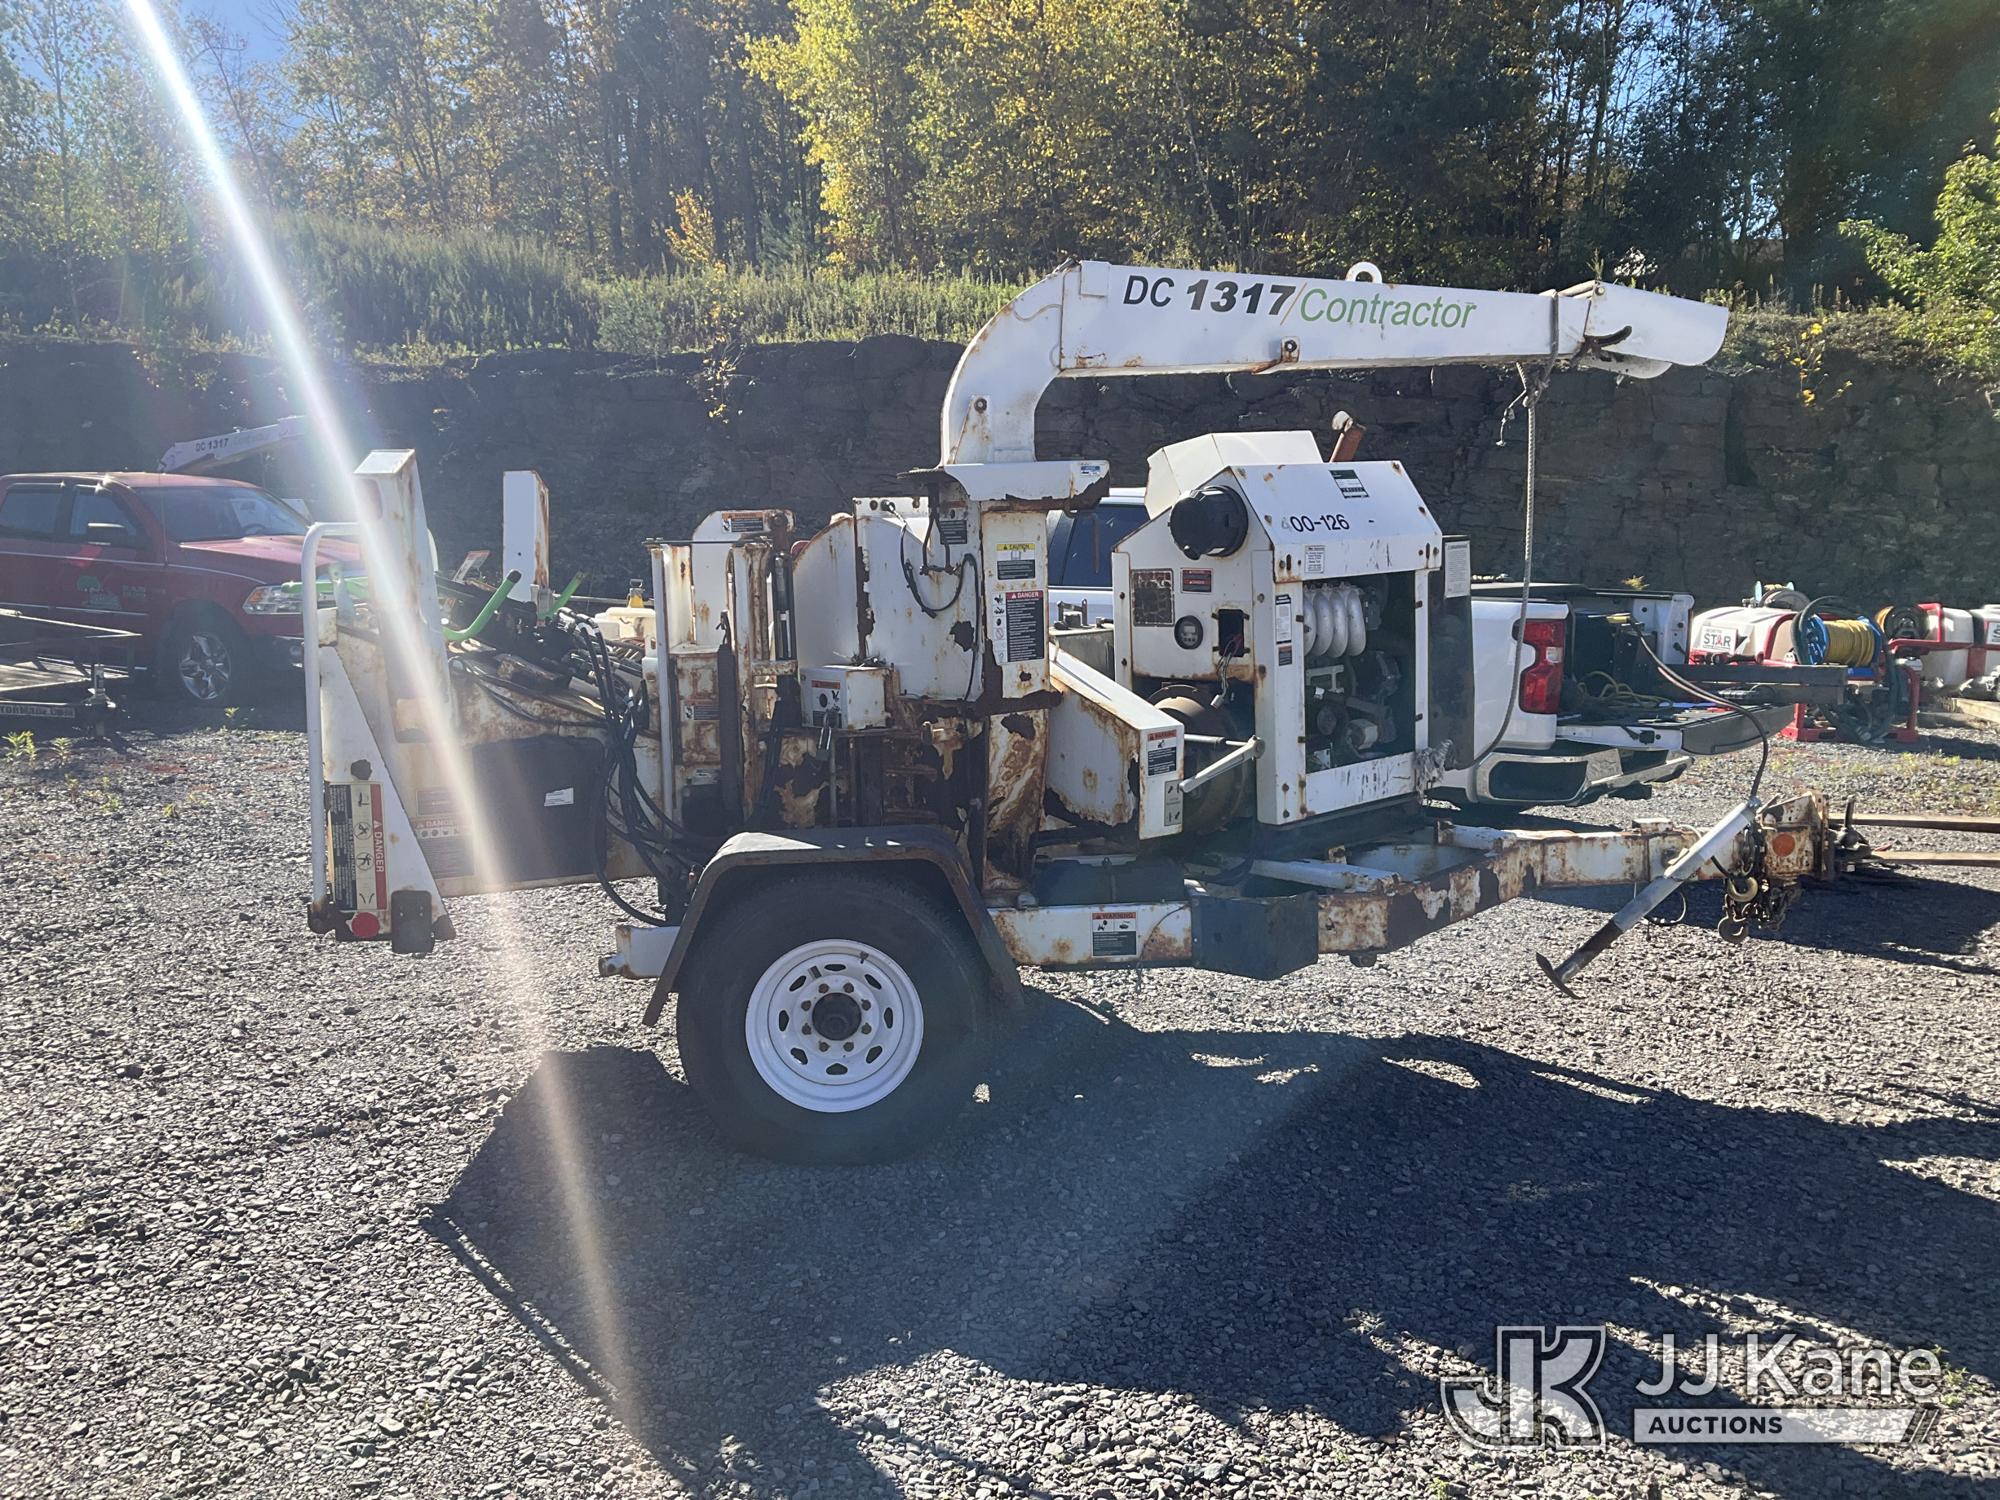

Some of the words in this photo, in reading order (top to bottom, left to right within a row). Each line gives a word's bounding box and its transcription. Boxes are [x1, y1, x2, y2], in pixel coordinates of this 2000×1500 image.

[1123, 275, 1174, 307] DC
[207, 438, 229, 450] 1317
[1017, 591, 1039, 599] DANGER
[1703, 633, 1731, 647] STAR
[373, 831, 385, 873] DANGER
